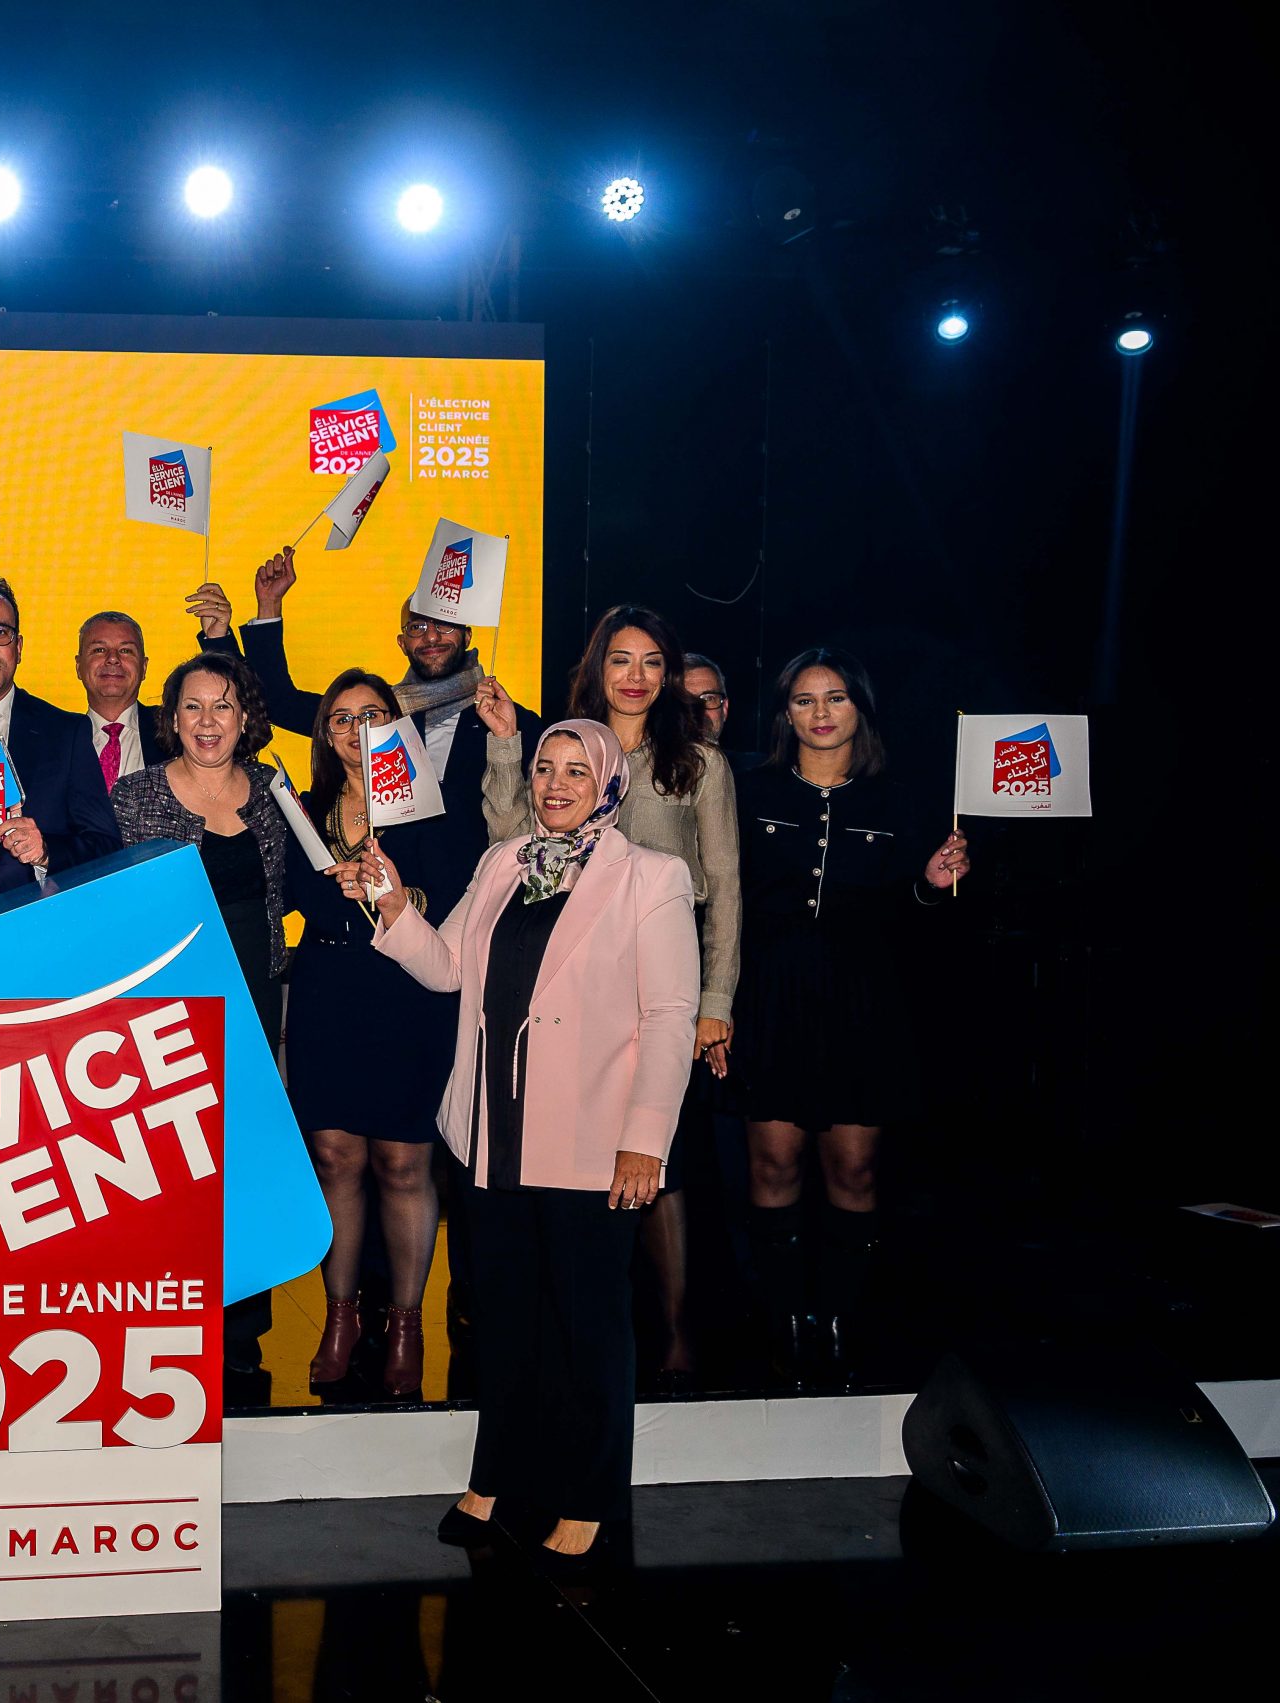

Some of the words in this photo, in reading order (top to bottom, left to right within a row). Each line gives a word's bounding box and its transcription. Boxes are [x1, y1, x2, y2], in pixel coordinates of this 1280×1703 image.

[419, 396, 490, 408] L'ÉLECTION
[314, 414, 338, 428] ÉLU
[419, 411, 437, 420] DU
[440, 411, 490, 420] SERVICE
[309, 412, 377, 443] SERVICE
[419, 423, 462, 432] CLIENT
[314, 424, 379, 455] CLIENT
[419, 436, 435, 444] DE
[438, 433, 490, 444] L'ANNÉE
[418, 446, 490, 467] 2025
[314, 456, 369, 475] 202
[150, 466, 184, 483] SERVICE
[418, 470, 437, 478] AU
[442, 470, 490, 479] MAROC
[152, 475, 185, 492] CLIENT
[151, 493, 185, 512] 2025
[438, 555, 467, 572] SERVICE
[437, 565, 467, 582] CLIENT
[431, 583, 460, 604] 2025
[994, 751, 1028, 769] خدمة
[1031, 744, 1046, 761] في
[372, 786, 412, 804] 2025
[996, 780, 1049, 796] 2025
[40, 1272, 204, 1314] L'ANNÉE
[8, 1523, 199, 1558] MAROC
